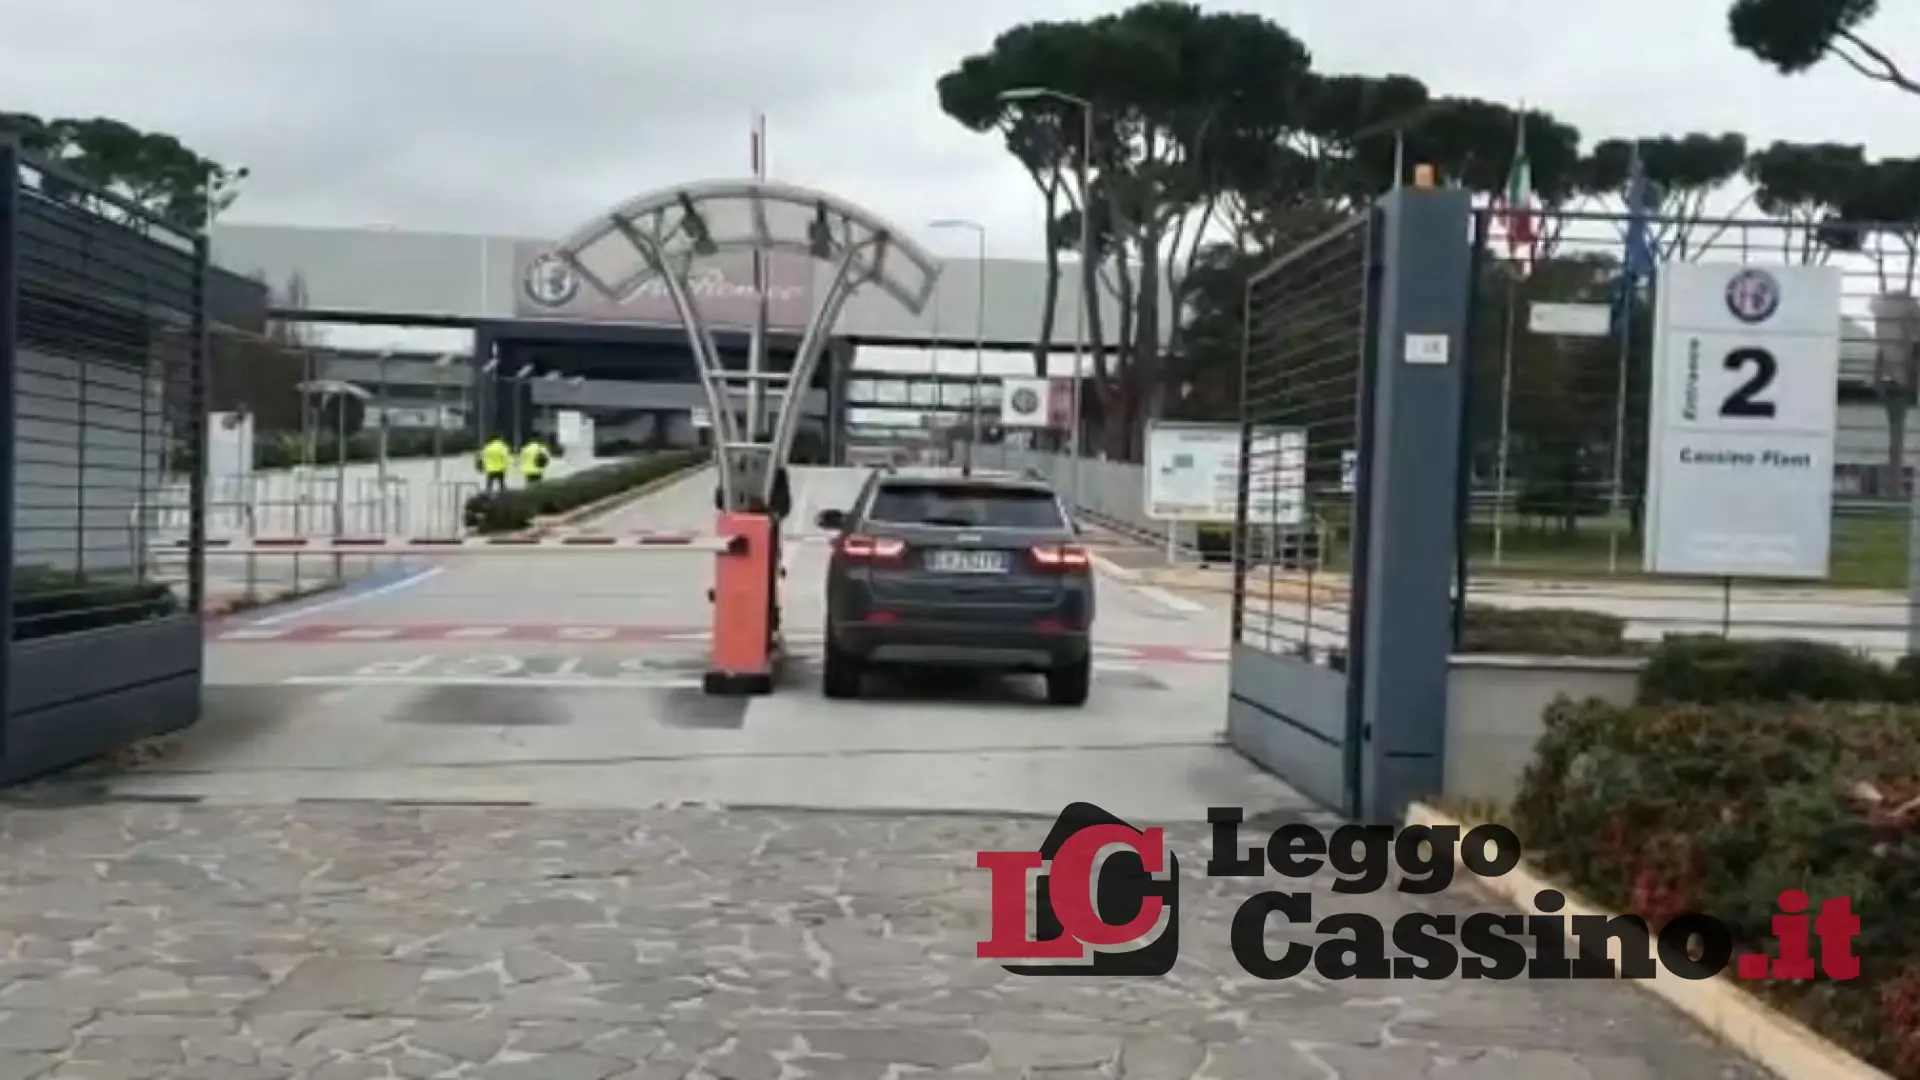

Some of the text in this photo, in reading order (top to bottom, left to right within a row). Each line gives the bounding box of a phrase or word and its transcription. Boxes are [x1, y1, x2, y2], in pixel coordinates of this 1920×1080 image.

[1720, 347, 1777, 418] 2
[1679, 447, 1811, 469] Cassino Plant
